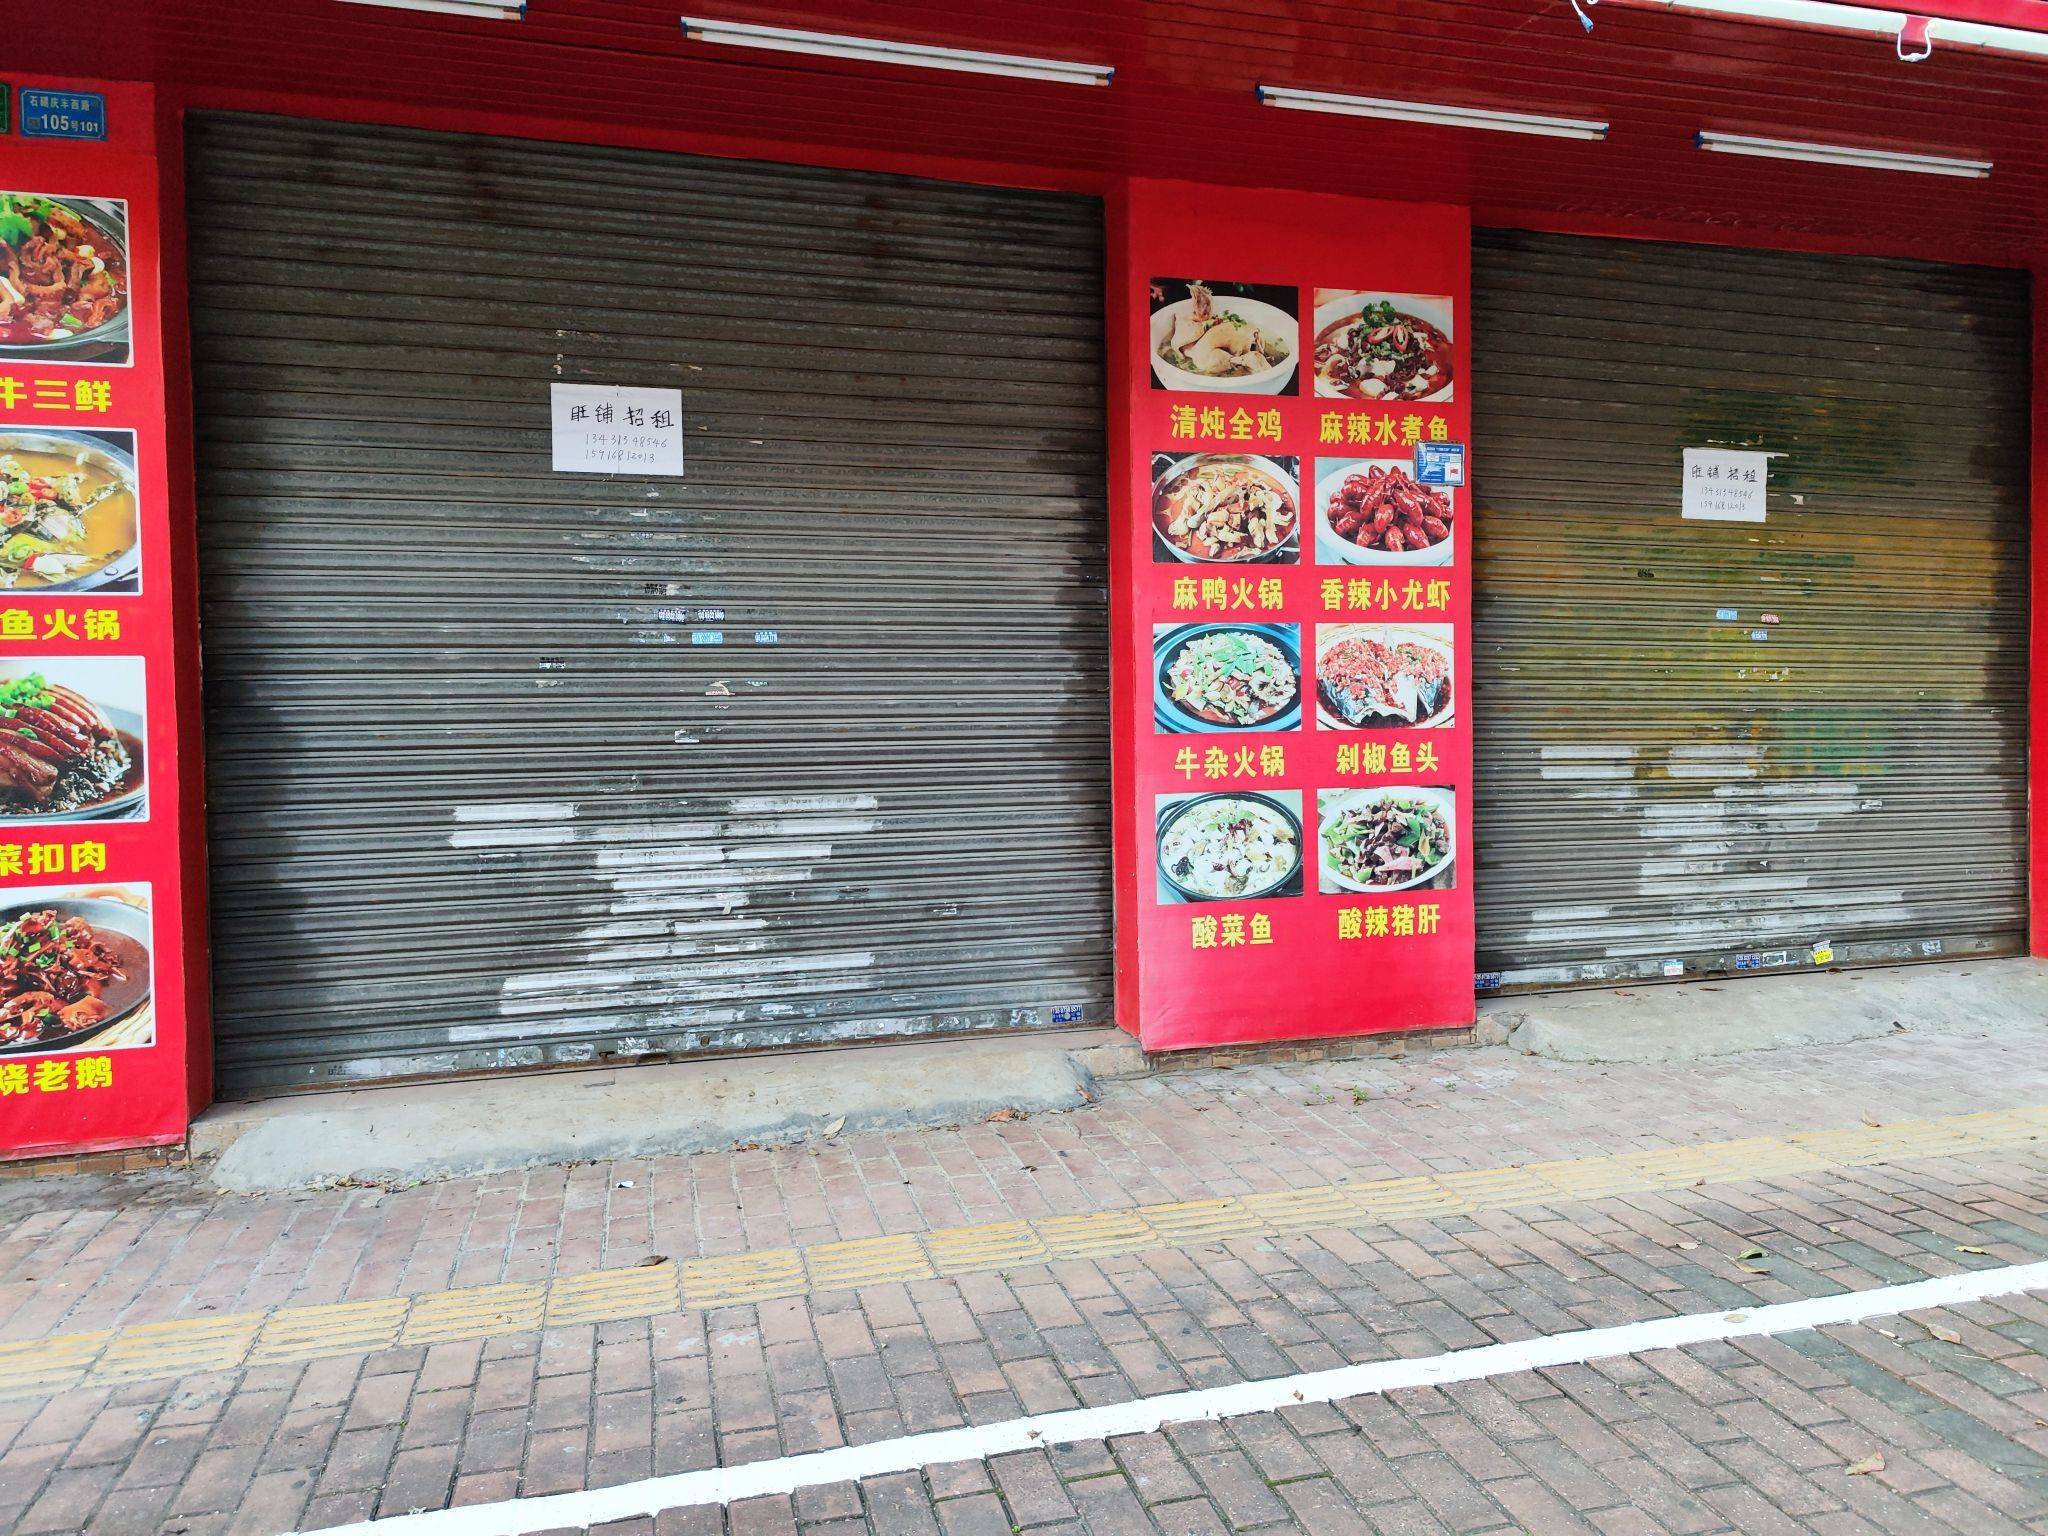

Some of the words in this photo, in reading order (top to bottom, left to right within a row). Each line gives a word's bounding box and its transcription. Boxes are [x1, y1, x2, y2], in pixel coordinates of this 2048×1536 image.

[0, 377, 112, 412] 牛三鲜
[570, 402, 674, 428] 旺铺招租
[1169, 404, 1283, 442] 清炖全鸡
[1319, 411, 1449, 445] 麻辣水煮鱼
[1692, 464, 1758, 482] 旺铺招租
[1172, 576, 1284, 610] 麻鸭火锅
[0, 608, 120, 640] 鱼火锅
[1175, 745, 1285, 780] 牛杂火锅
[1336, 741, 1439, 775] 剁椒鱼头
[0, 841, 106, 875] 菜扣肉
[1191, 912, 1274, 949] 酸菜鱼
[1338, 903, 1441, 940] 酸辣猪肝
[0, 1056, 113, 1096] 烧老鹅
